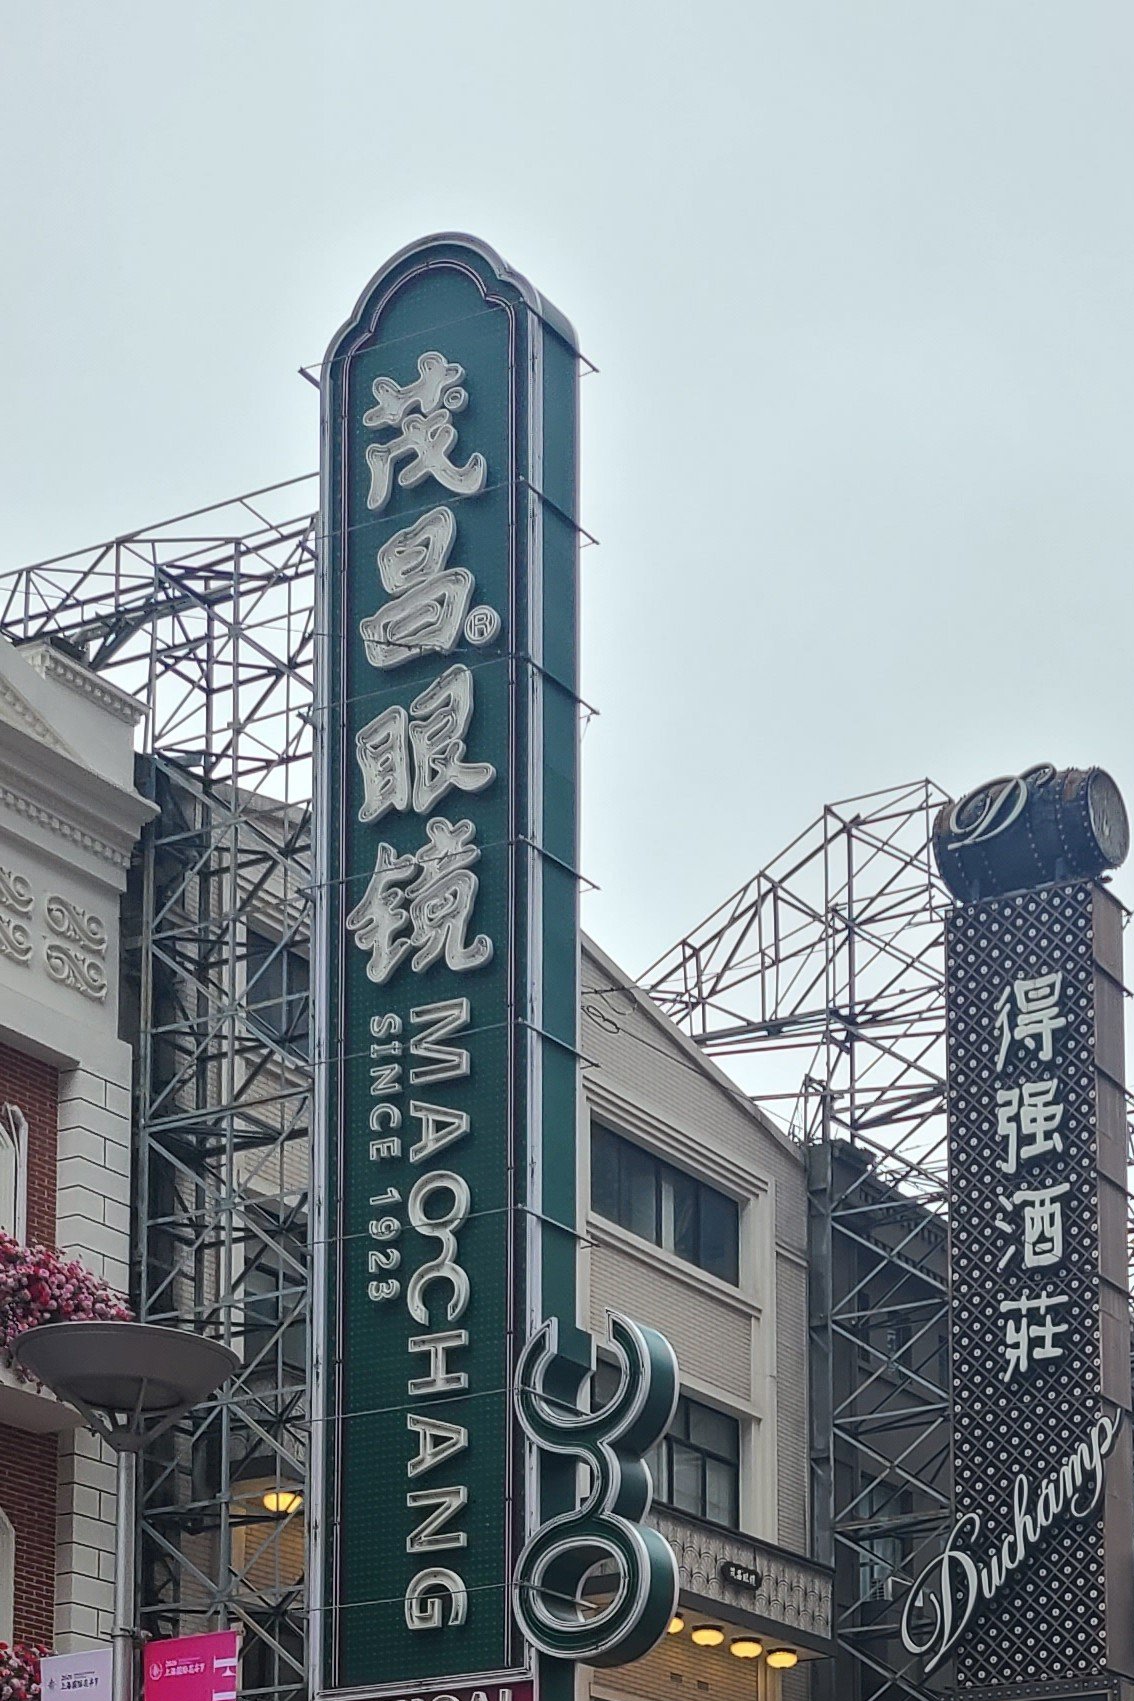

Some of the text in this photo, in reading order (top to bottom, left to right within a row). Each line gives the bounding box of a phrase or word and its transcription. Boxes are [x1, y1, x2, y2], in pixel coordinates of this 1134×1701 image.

[347, 350, 497, 984] 茂昌眼镜
[368, 1014, 401, 1301] SINCE 1923
[407, 996, 471, 1631] MAOCHANG
[901, 1408, 1121, 1672] Duchamp
